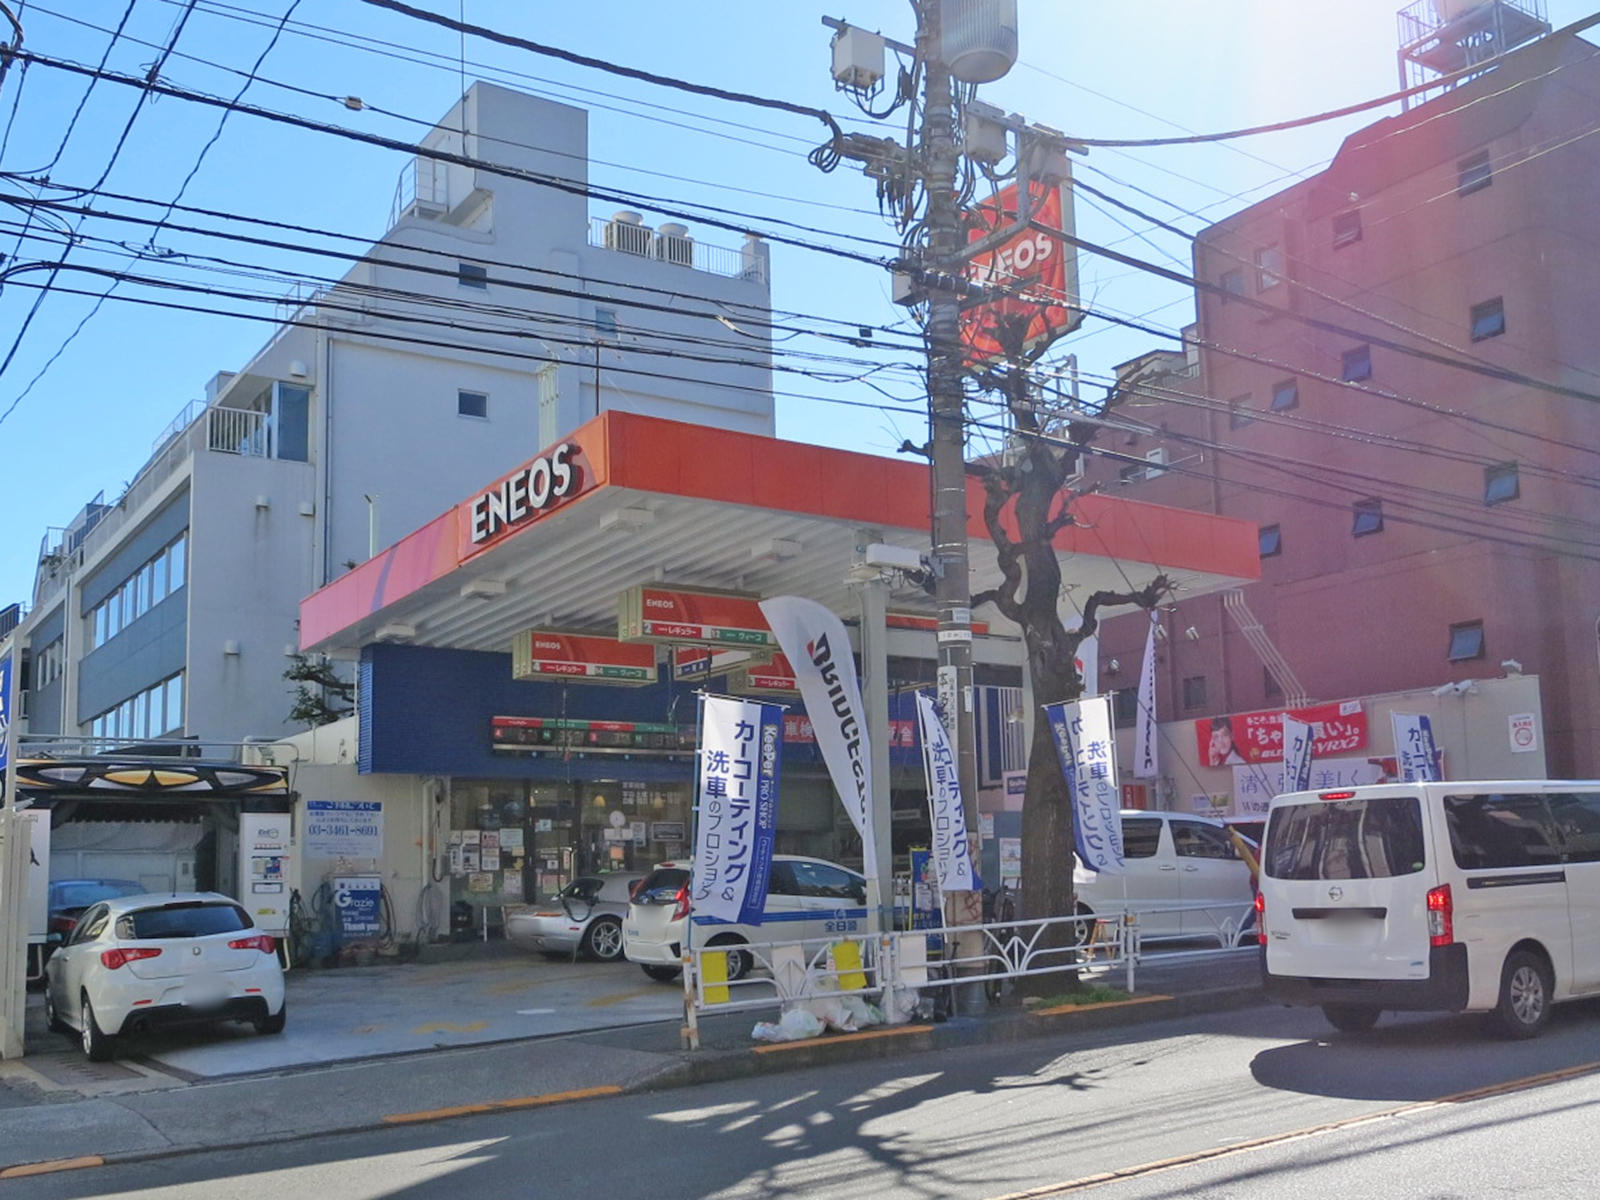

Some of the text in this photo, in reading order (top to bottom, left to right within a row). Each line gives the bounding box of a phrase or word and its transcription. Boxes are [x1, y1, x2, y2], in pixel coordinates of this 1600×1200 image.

[471, 443, 571, 543] ENEOS
[646, 598, 674, 609] ENEOS
[535, 641, 561, 650] ENEOS
[644, 623, 653, 634] 2
[668, 627, 697, 636] レギュラー
[762, 725, 778, 779] KeePer
[721, 720, 755, 902] カーコーティング&
[758, 780, 769, 829] PRO SHOP
[308, 825, 378, 836] 03-3461-8691
[696, 750, 730, 900] 洗車のプロショップ
[335, 890, 375, 908] Grazie
